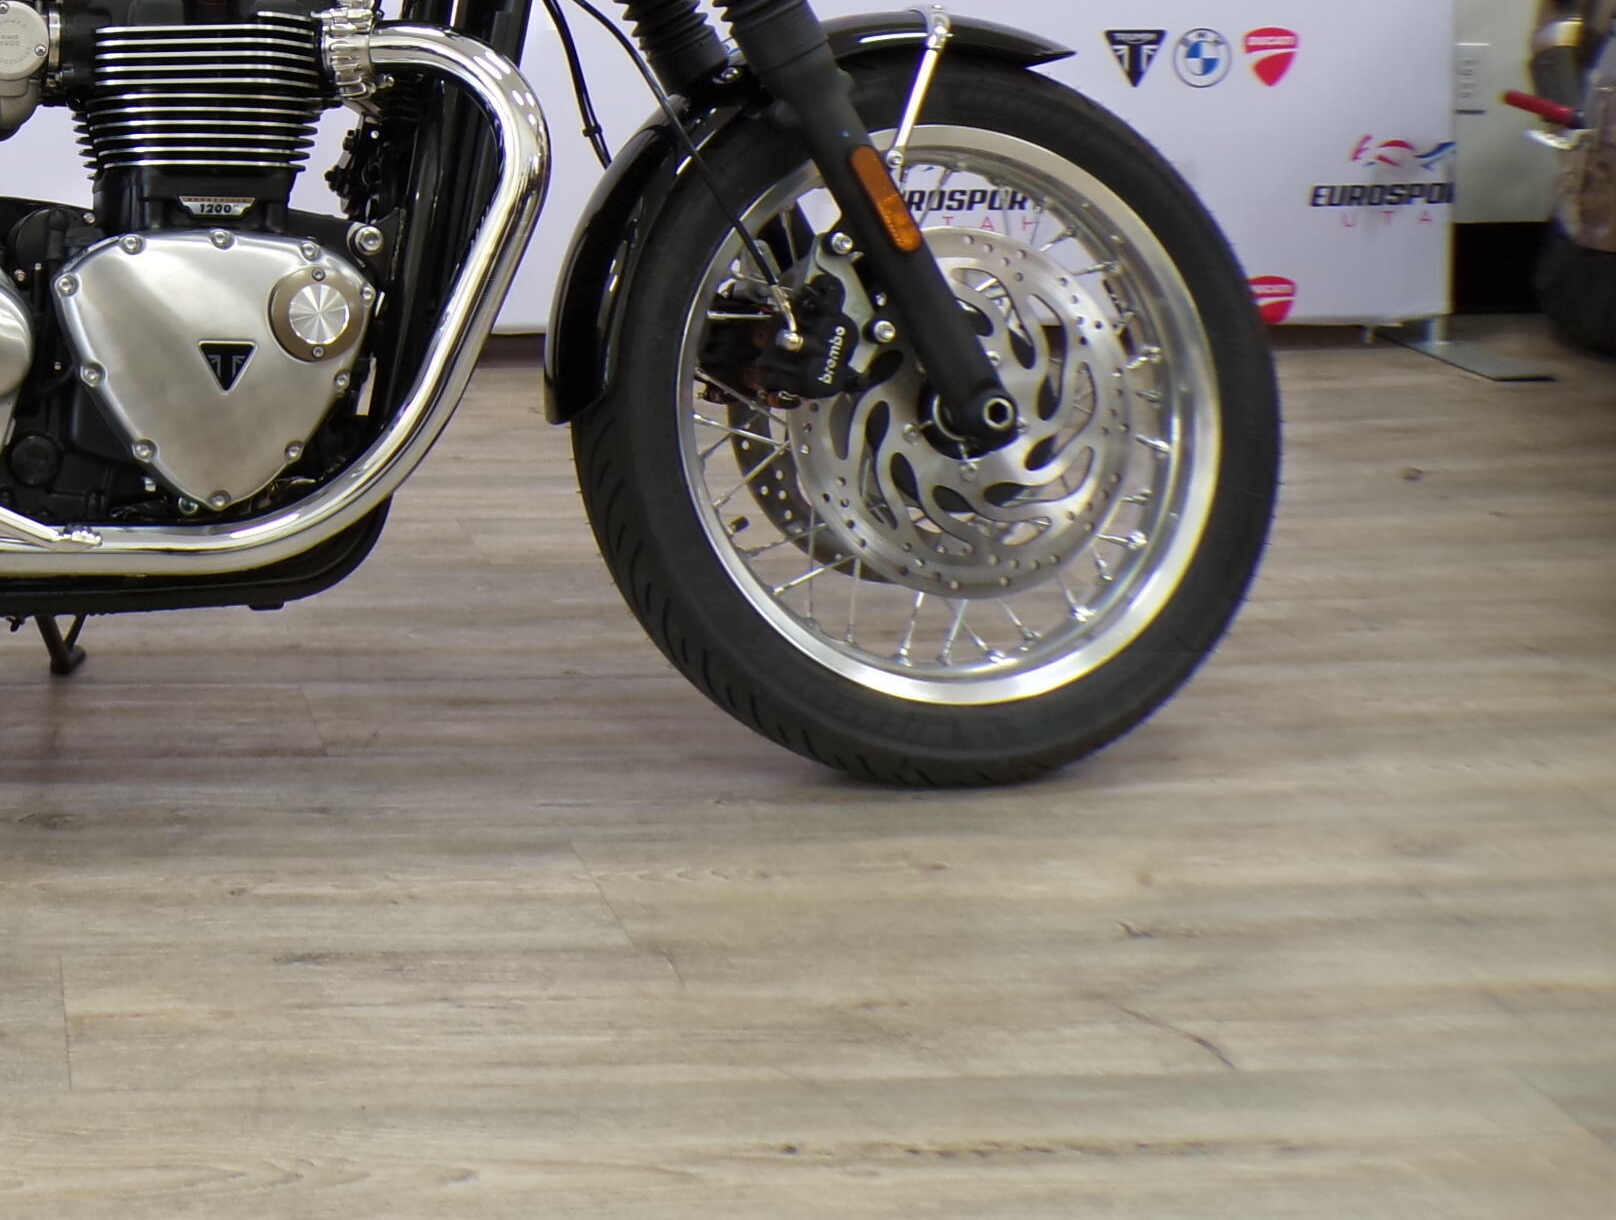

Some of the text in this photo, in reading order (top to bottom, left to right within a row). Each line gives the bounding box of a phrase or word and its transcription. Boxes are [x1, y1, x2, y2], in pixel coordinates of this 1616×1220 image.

[906, 189, 1029, 211] ROSPOR
[942, 216, 1039, 231] TAH
[1343, 211, 1432, 227] UTA
[818, 326, 846, 385] brembo
